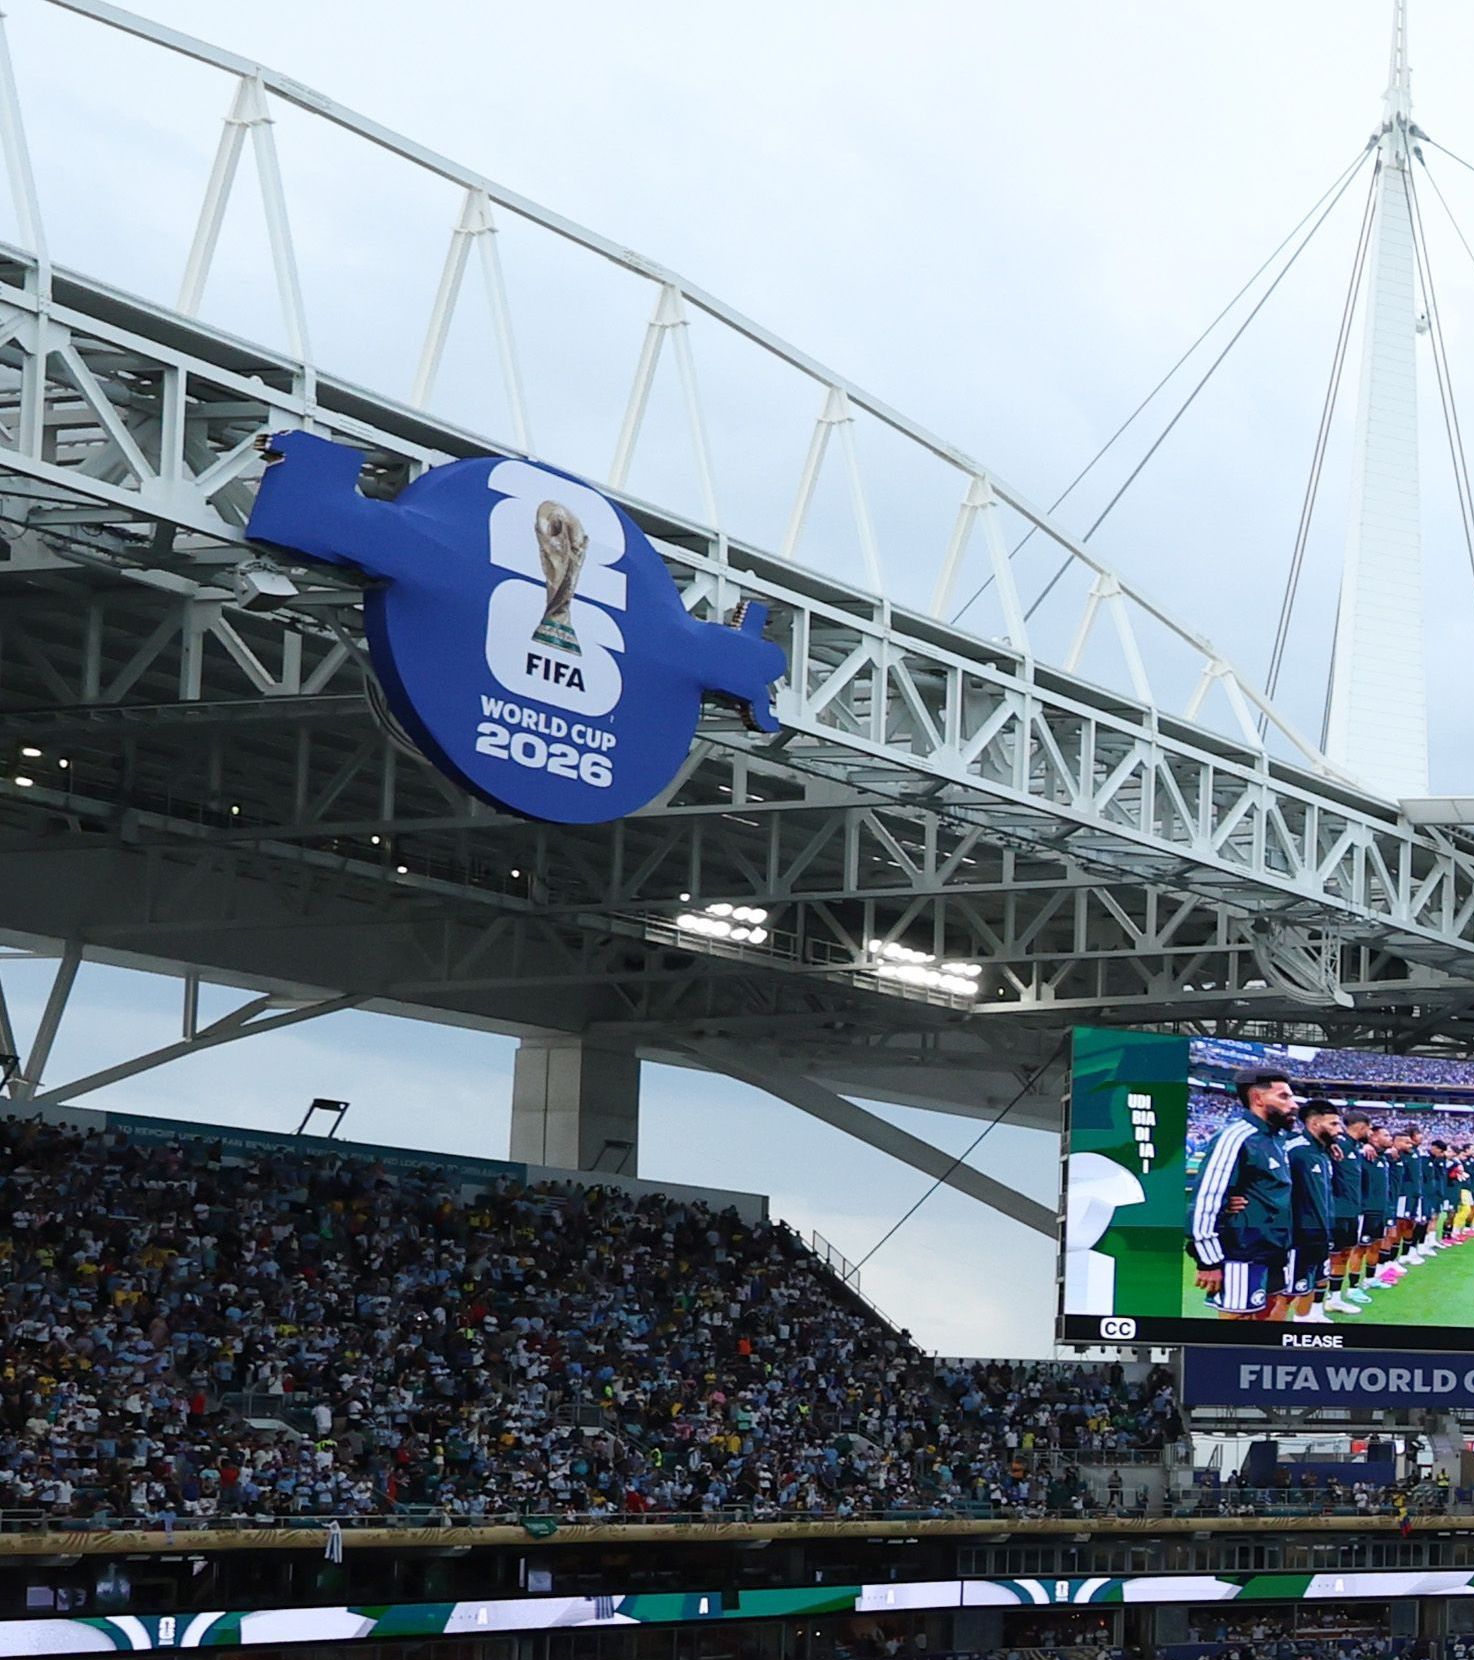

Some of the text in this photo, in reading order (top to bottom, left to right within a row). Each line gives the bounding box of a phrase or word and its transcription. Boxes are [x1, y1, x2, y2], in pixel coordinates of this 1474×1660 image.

[526, 653, 586, 693] FIFA
[480, 694, 617, 752] WORLD CUP
[474, 722, 613, 789] 2026
[1127, 1093, 1152, 1110] UDI
[1131, 1110, 1156, 1127] BIA
[1136, 1126, 1156, 1142] DI
[1139, 1142, 1155, 1159] IA
[1105, 1318, 1132, 1338] CC
[1282, 1332, 1344, 1349] PLEASE
[1239, 1363, 1319, 1391] FIFA
[1328, 1366, 1458, 1394] WORLD
